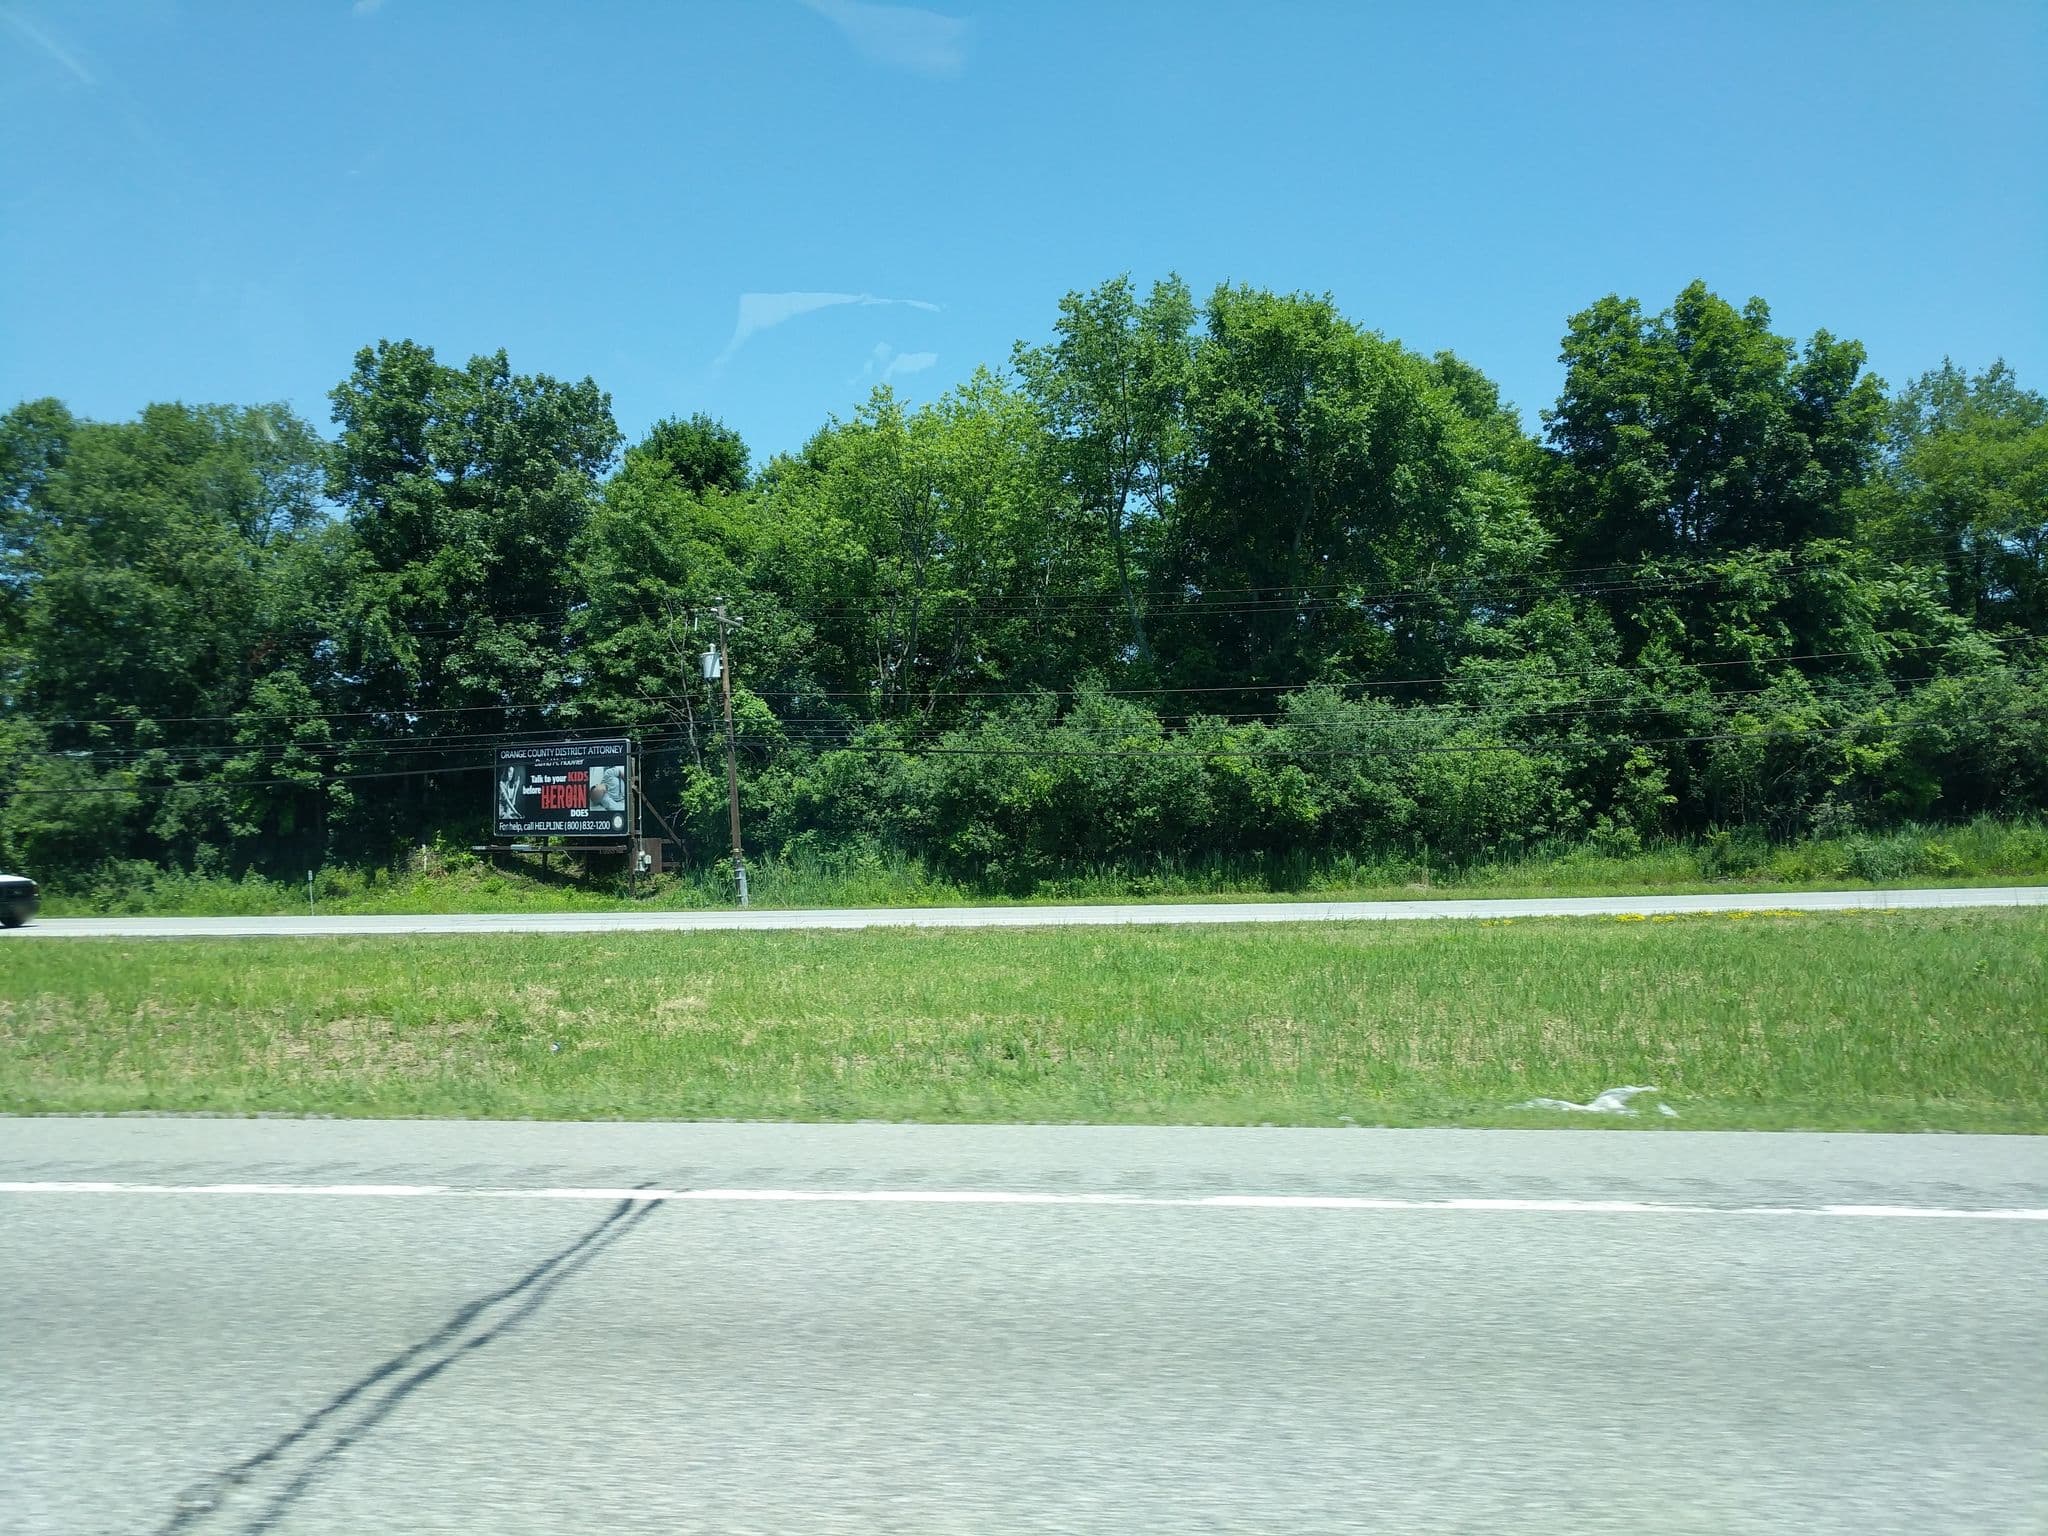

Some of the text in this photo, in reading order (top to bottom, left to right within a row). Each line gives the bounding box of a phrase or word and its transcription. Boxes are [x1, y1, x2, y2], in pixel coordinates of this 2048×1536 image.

[500, 746, 623, 759] ORANGE COUNTY DISTRICT ATTORNEY
[530, 771, 588, 784] Talk to your KIDS
[522, 784, 586, 809] before HEROIN
[524, 822, 534, 830] call
[535, 821, 564, 830] HELPLINE
[564, 821, 582, 831] (800)
[582, 821, 610, 830] 832-1200
